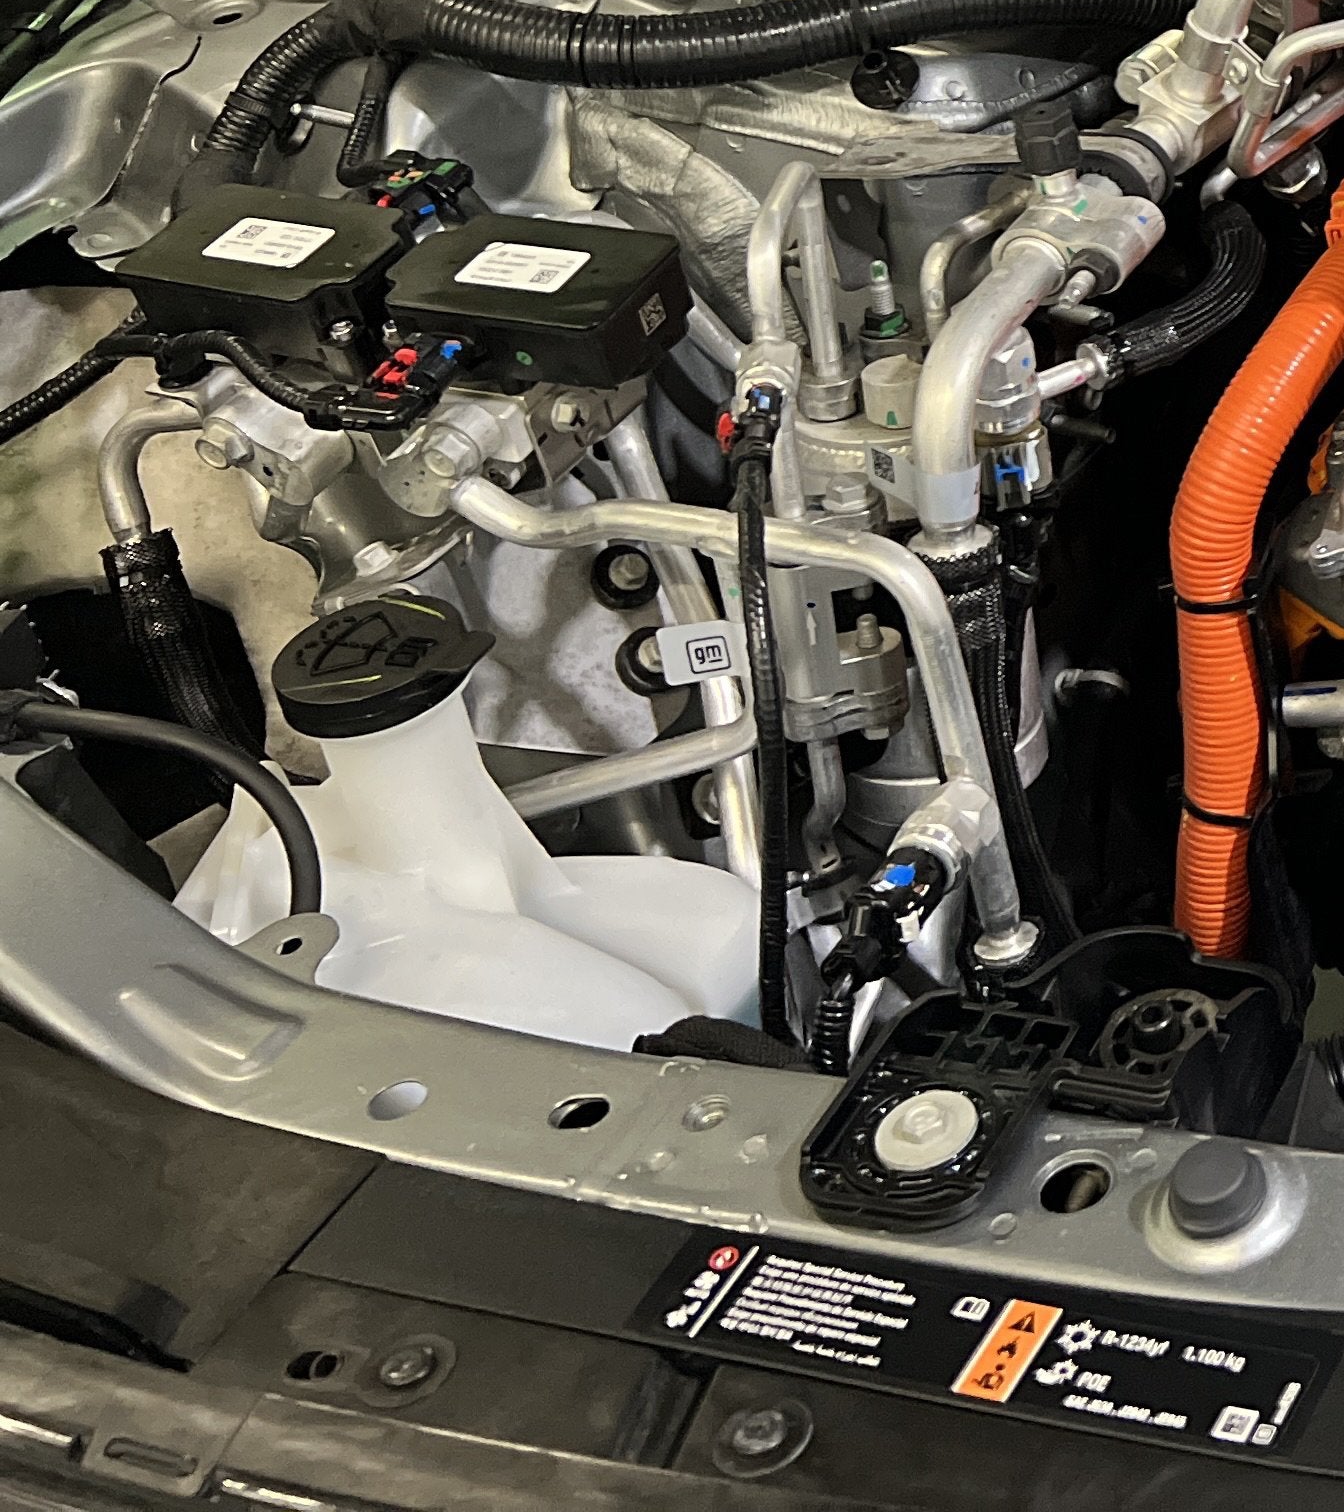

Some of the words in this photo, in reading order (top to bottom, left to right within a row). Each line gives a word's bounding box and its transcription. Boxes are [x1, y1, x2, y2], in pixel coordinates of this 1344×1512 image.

[693, 644, 723, 665] gm
[1100, 1329, 1172, 1358] R-1234yf
[1181, 1344, 1225, 1368] 1.100
[1225, 1349, 1248, 1374] kg
[1076, 1370, 1113, 1393] POE
